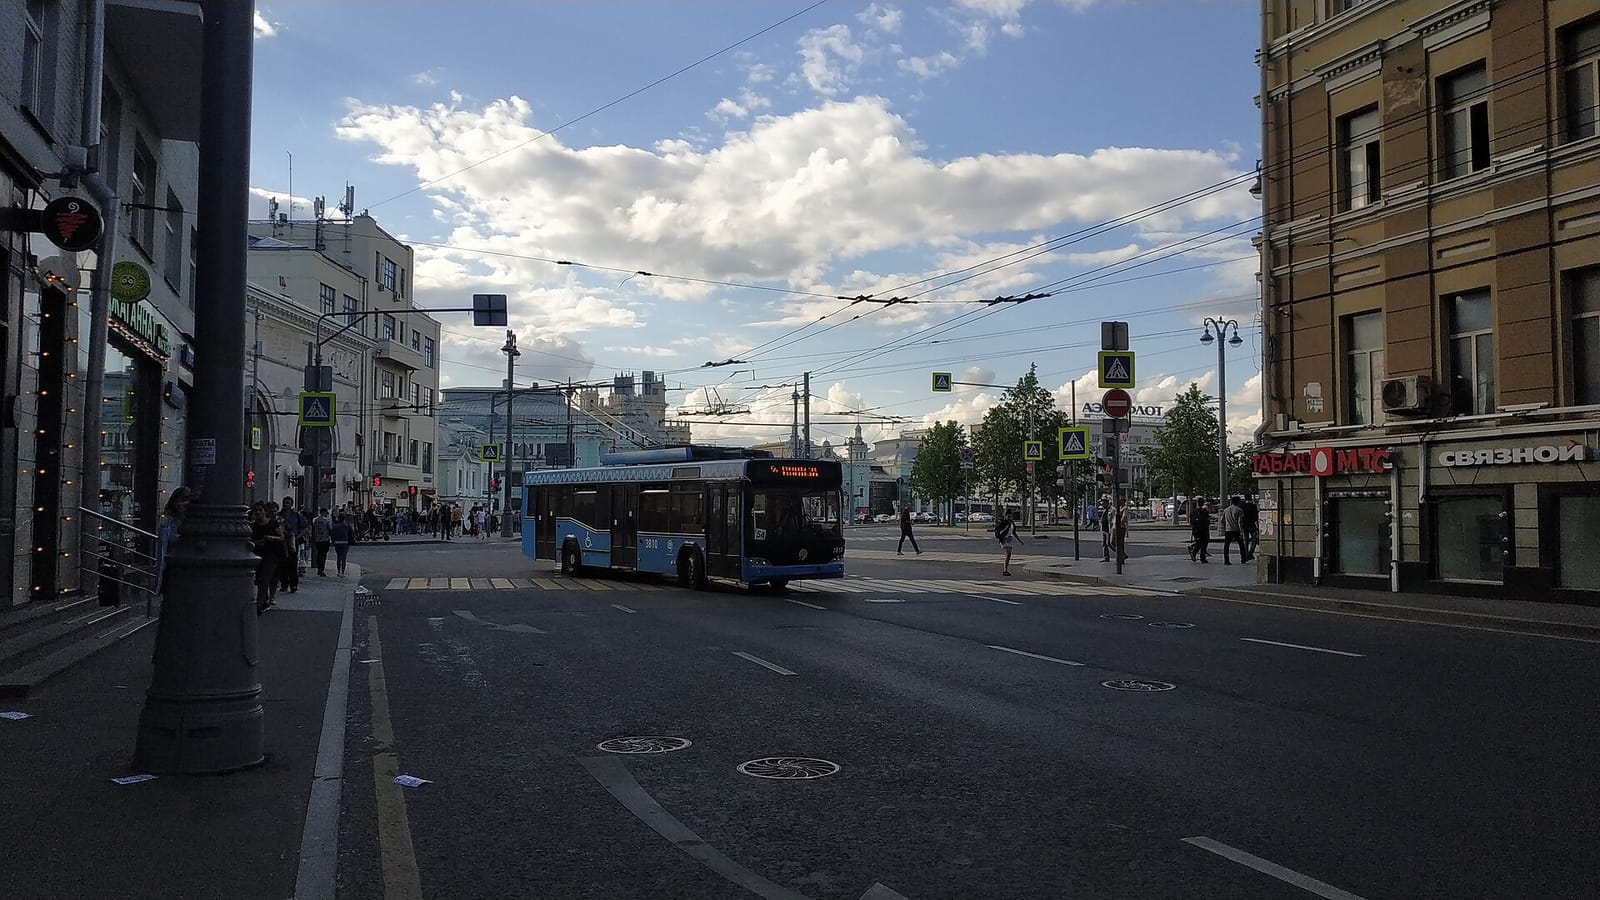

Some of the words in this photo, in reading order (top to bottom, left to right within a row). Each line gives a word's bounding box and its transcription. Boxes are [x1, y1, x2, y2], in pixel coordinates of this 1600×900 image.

[1251, 452, 1312, 473] ТАБАК
[1337, 448, 1391, 473] МТС
[1438, 442, 1584, 467] СВЯЗНОЙ
[644, 538, 659, 549] 3810
